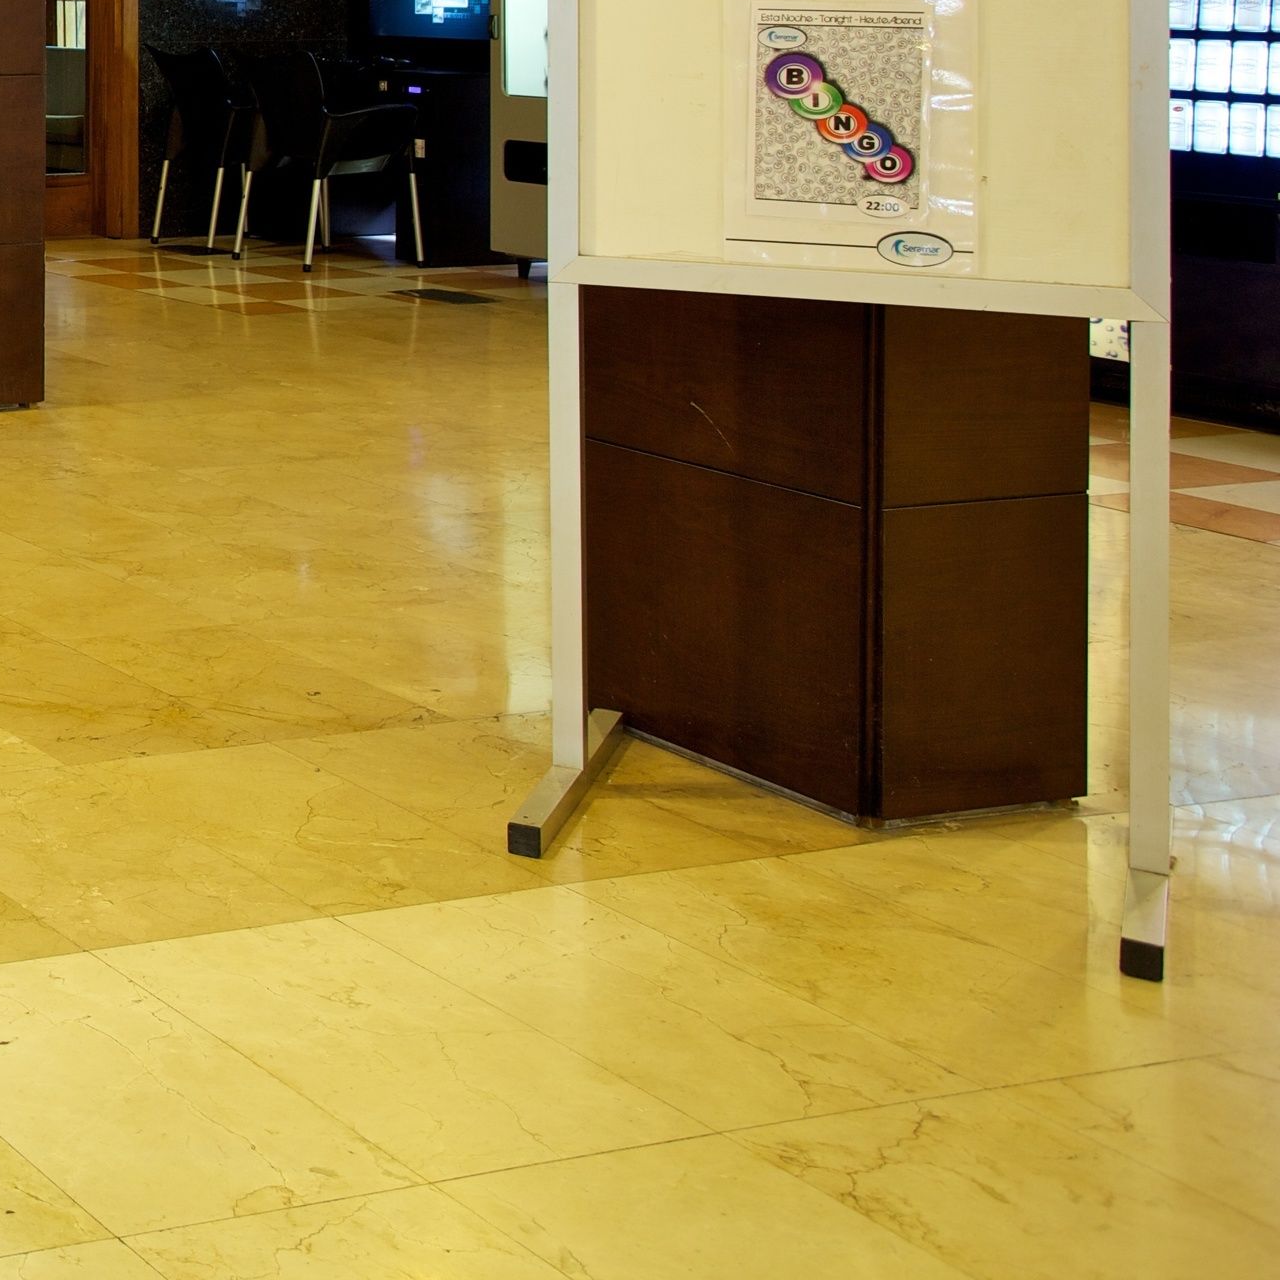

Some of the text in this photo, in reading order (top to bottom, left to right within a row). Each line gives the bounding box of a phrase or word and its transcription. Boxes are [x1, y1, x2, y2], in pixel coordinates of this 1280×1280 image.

[761, 13, 780, 22] Esta
[780, 13, 813, 22] Noche
[819, 14, 853, 25] Tonight
[860, 16, 889, 25] Heute
[866, 202, 900, 212] 22:00
[902, 243, 941, 254] Seramar
